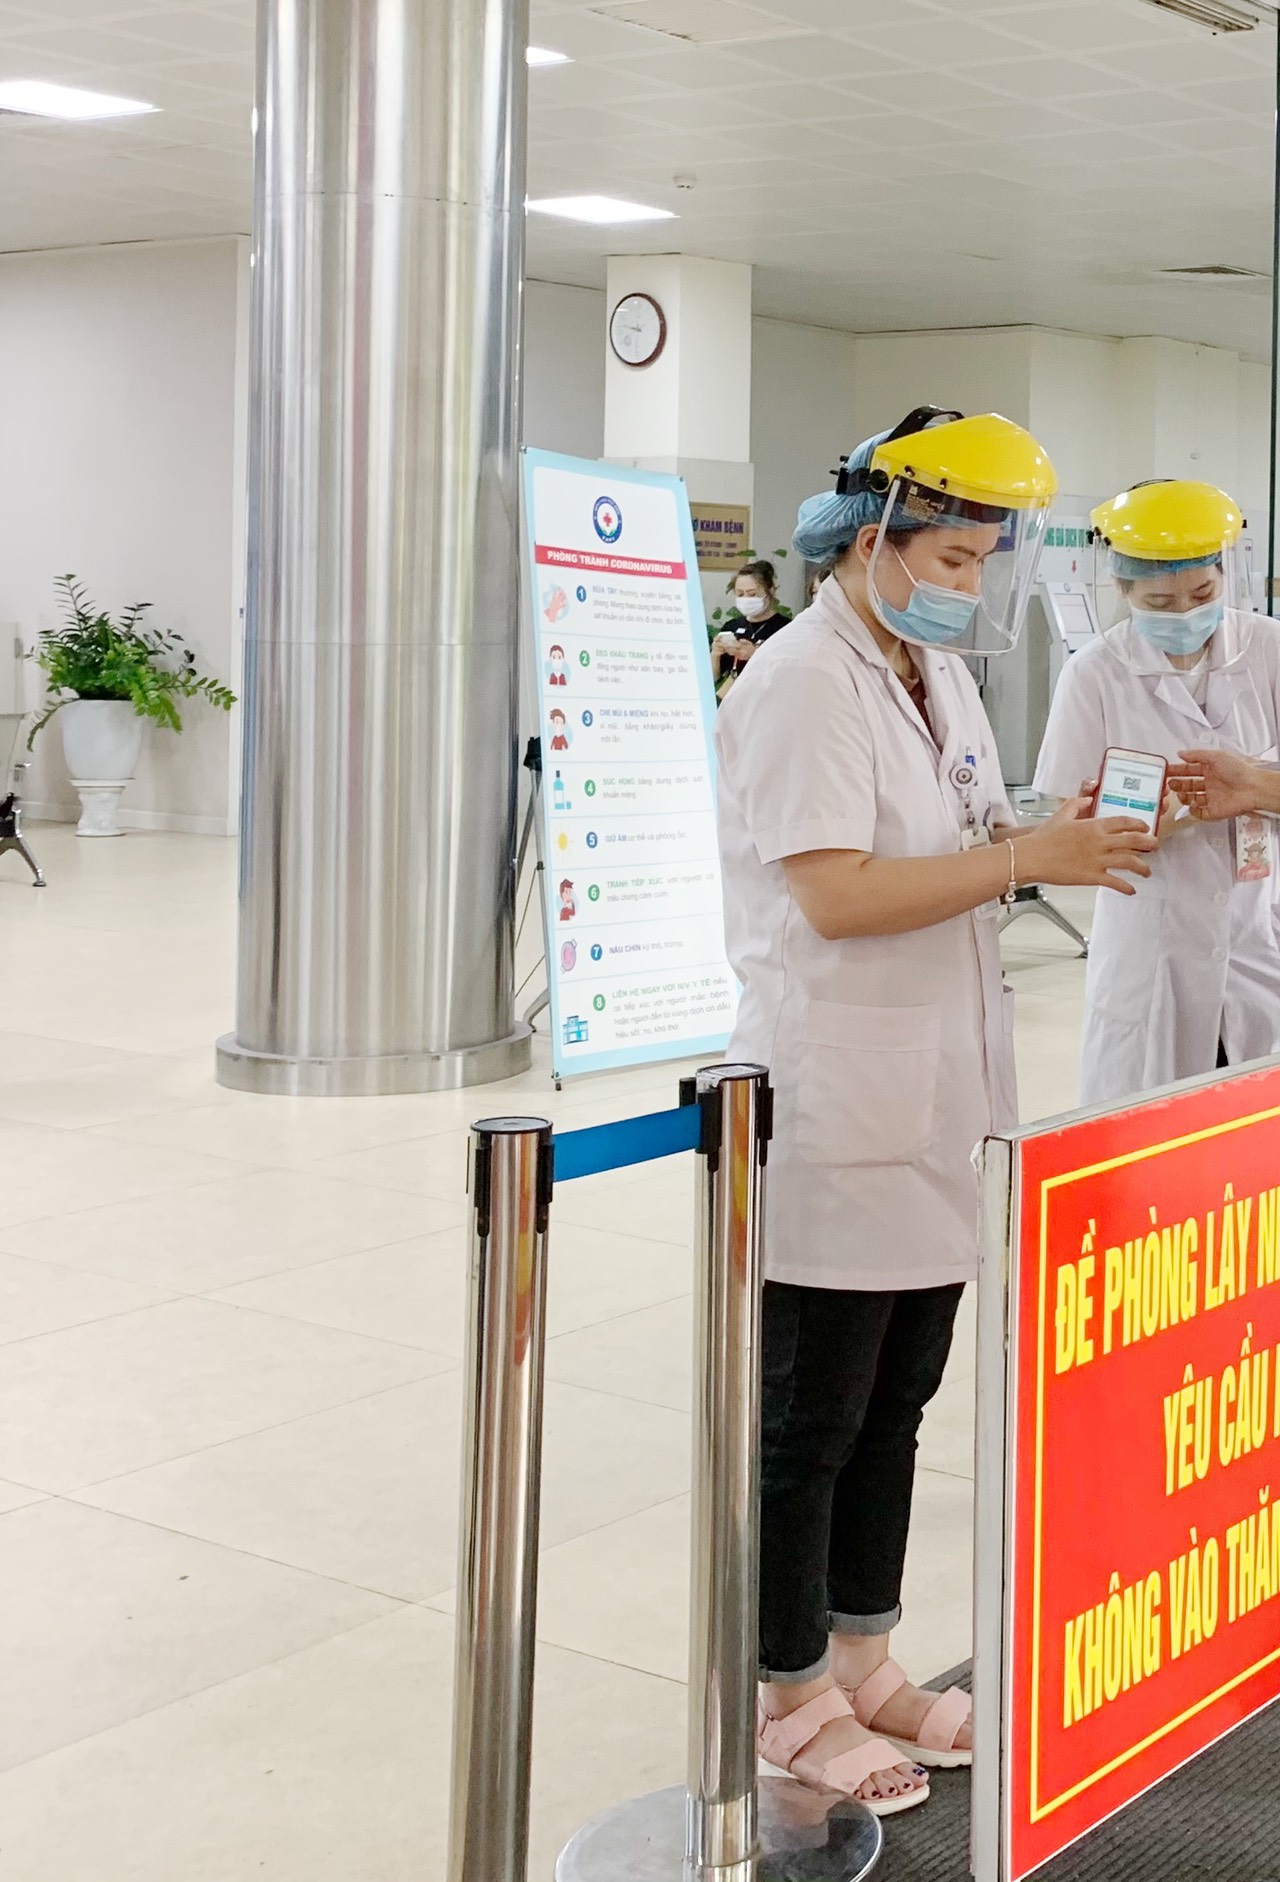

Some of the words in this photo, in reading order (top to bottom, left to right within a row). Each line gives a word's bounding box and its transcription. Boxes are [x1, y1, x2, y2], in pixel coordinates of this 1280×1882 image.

[547, 550, 578, 564] PHÒNG
[579, 553, 609, 568] TRÁNH
[610, 558, 673, 574] CORONAVIRUS
[1055, 1218, 1097, 1376] ĐỀ
[1103, 1205, 1198, 1356] PHÒNG
[1204, 1182, 1252, 1312] LÂY
[1163, 1363, 1213, 1496] YÊU
[1217, 1322, 1268, 1468] CẦU
[1063, 1571, 1162, 1729] KHÔNG
[1169, 1527, 1219, 1661] VÀO
